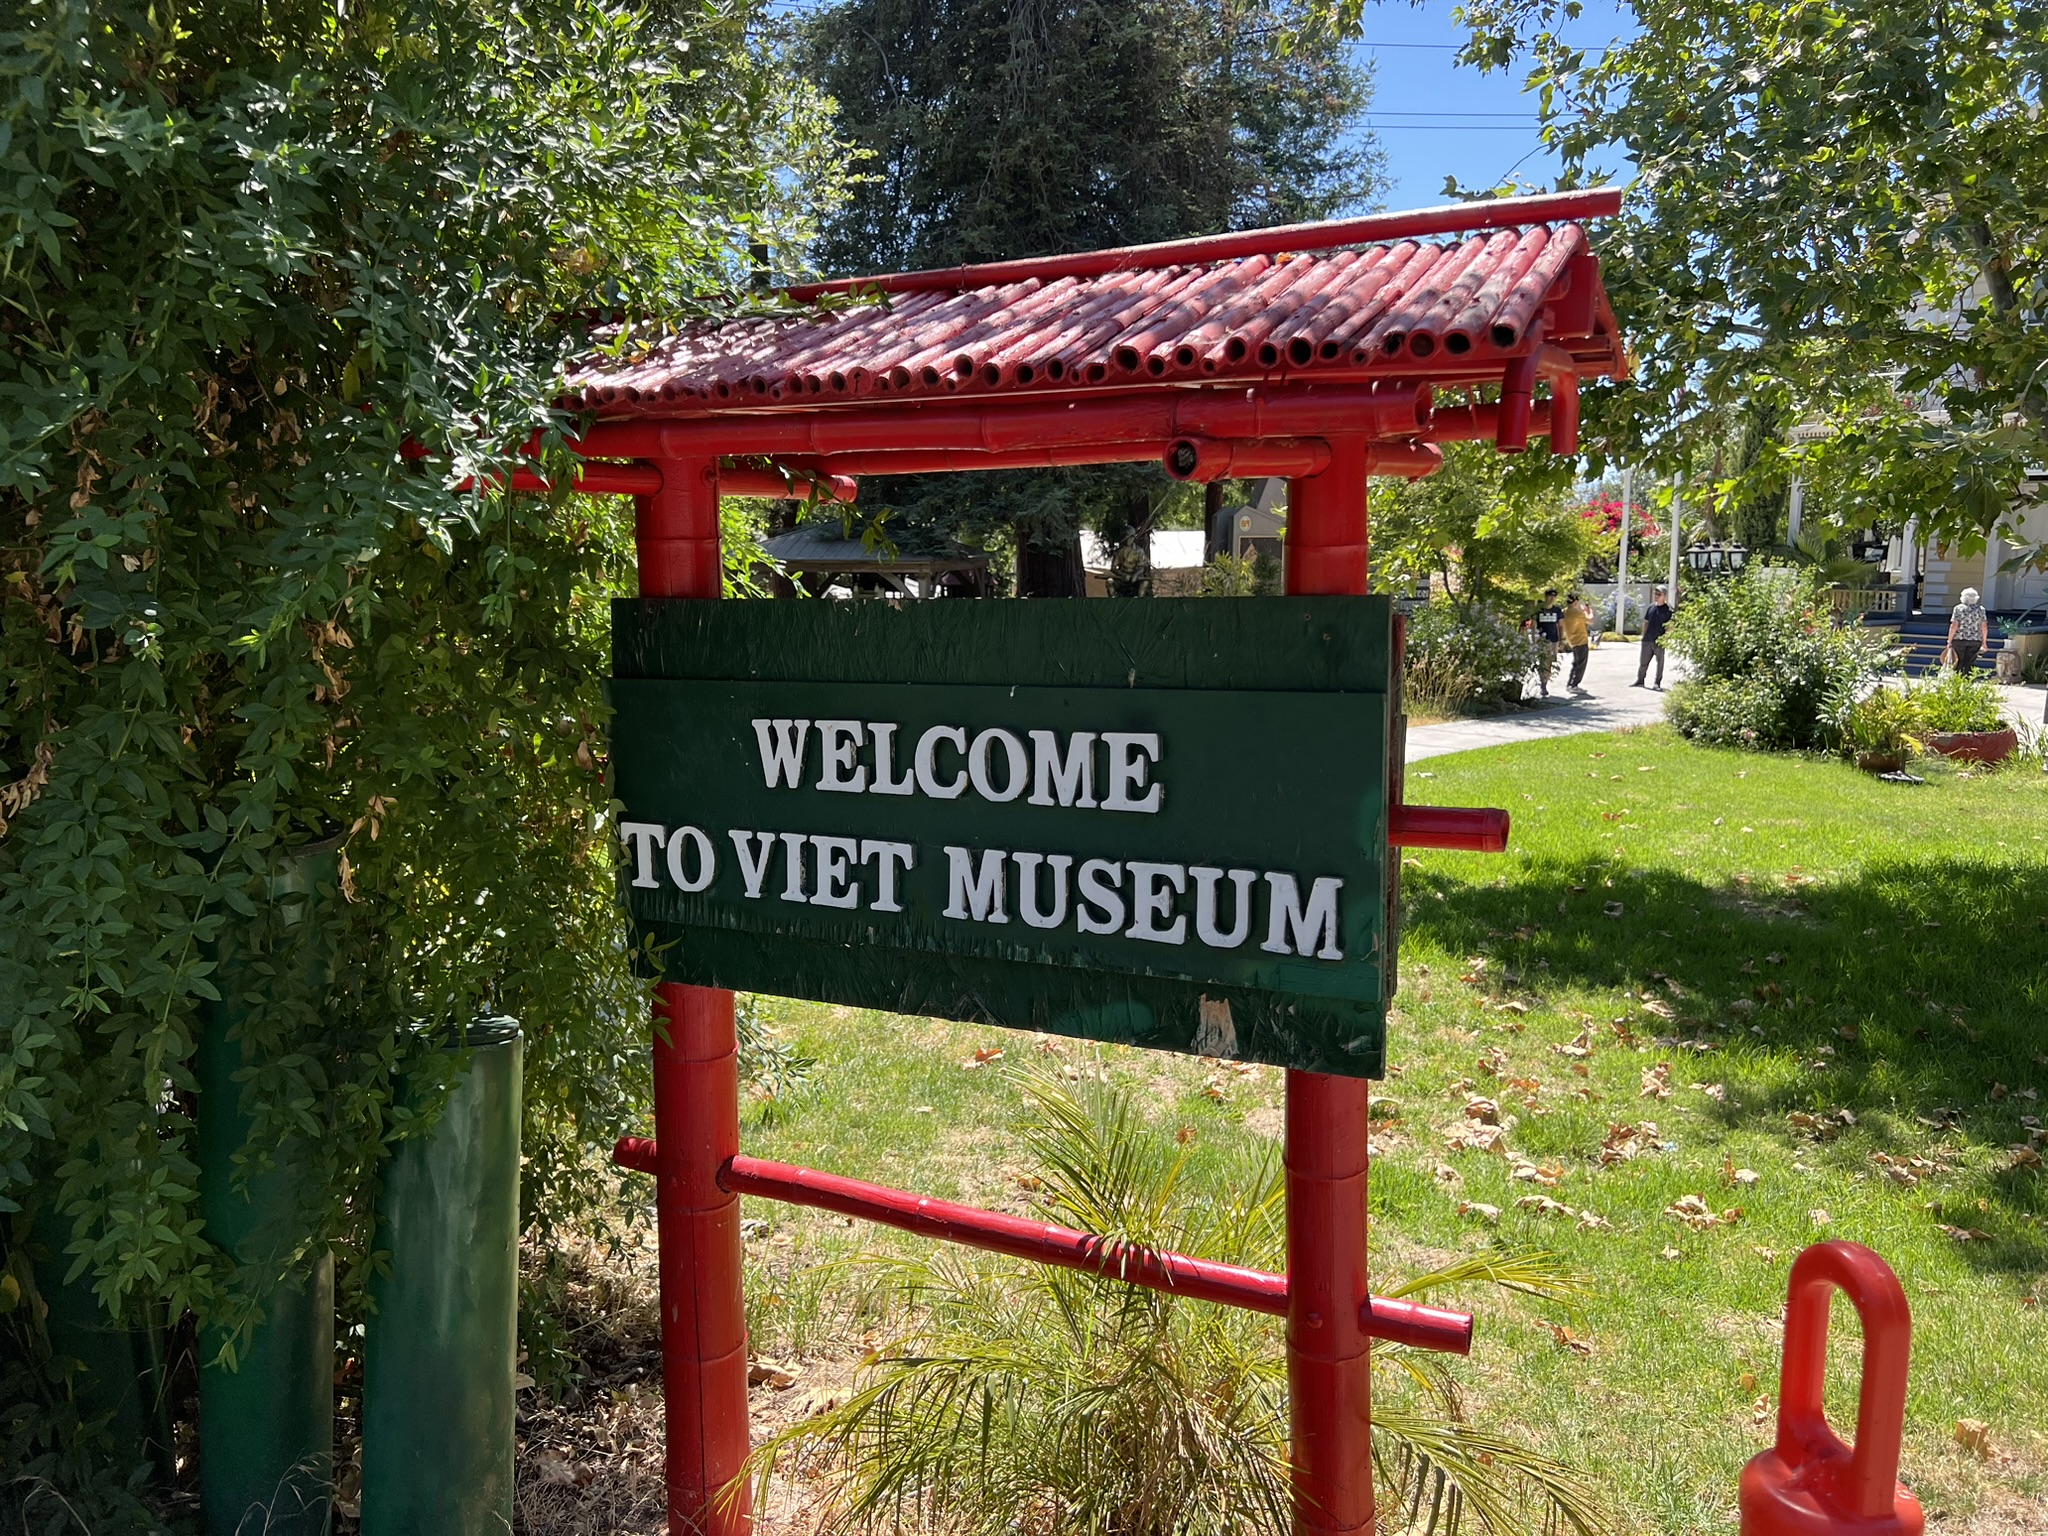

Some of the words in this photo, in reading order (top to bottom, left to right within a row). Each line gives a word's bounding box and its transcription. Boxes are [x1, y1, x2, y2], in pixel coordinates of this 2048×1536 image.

[751, 718, 1164, 814] WELCOME
[620, 821, 715, 892] TO
[728, 829, 914, 913] VIET
[942, 845, 1344, 961] MUSEUM
